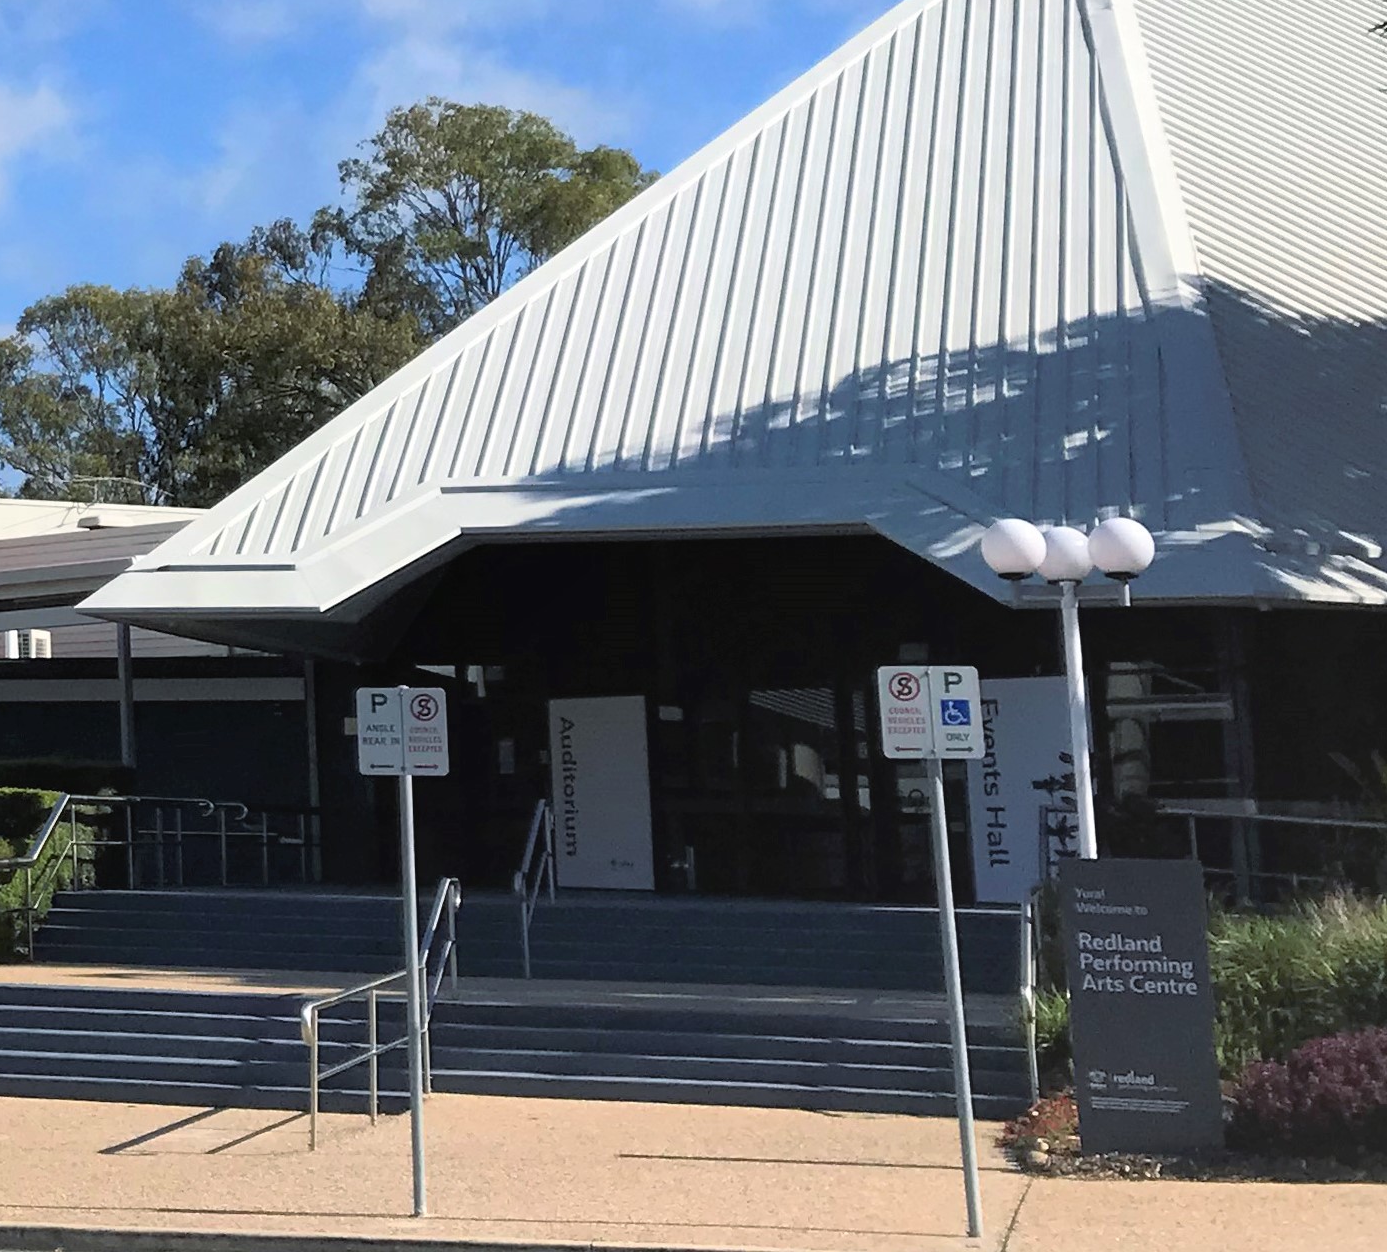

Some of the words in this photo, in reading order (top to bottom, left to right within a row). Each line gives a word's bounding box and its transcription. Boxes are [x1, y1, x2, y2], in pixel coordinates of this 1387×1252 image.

[944, 672, 963, 693] P
[371, 693, 388, 713] P
[946, 733, 970, 742] ONLY
[560, 716, 579, 857] Auditorium
[986, 806, 1010, 868] Hall
[1075, 902, 1132, 915] Welcome
[1134, 906, 1148, 916] to
[1078, 931, 1162, 953] Redland
[1079, 952, 1194, 979] Performing
[1082, 973, 1125, 992] Arts
[1129, 975, 1198, 995] Centre
